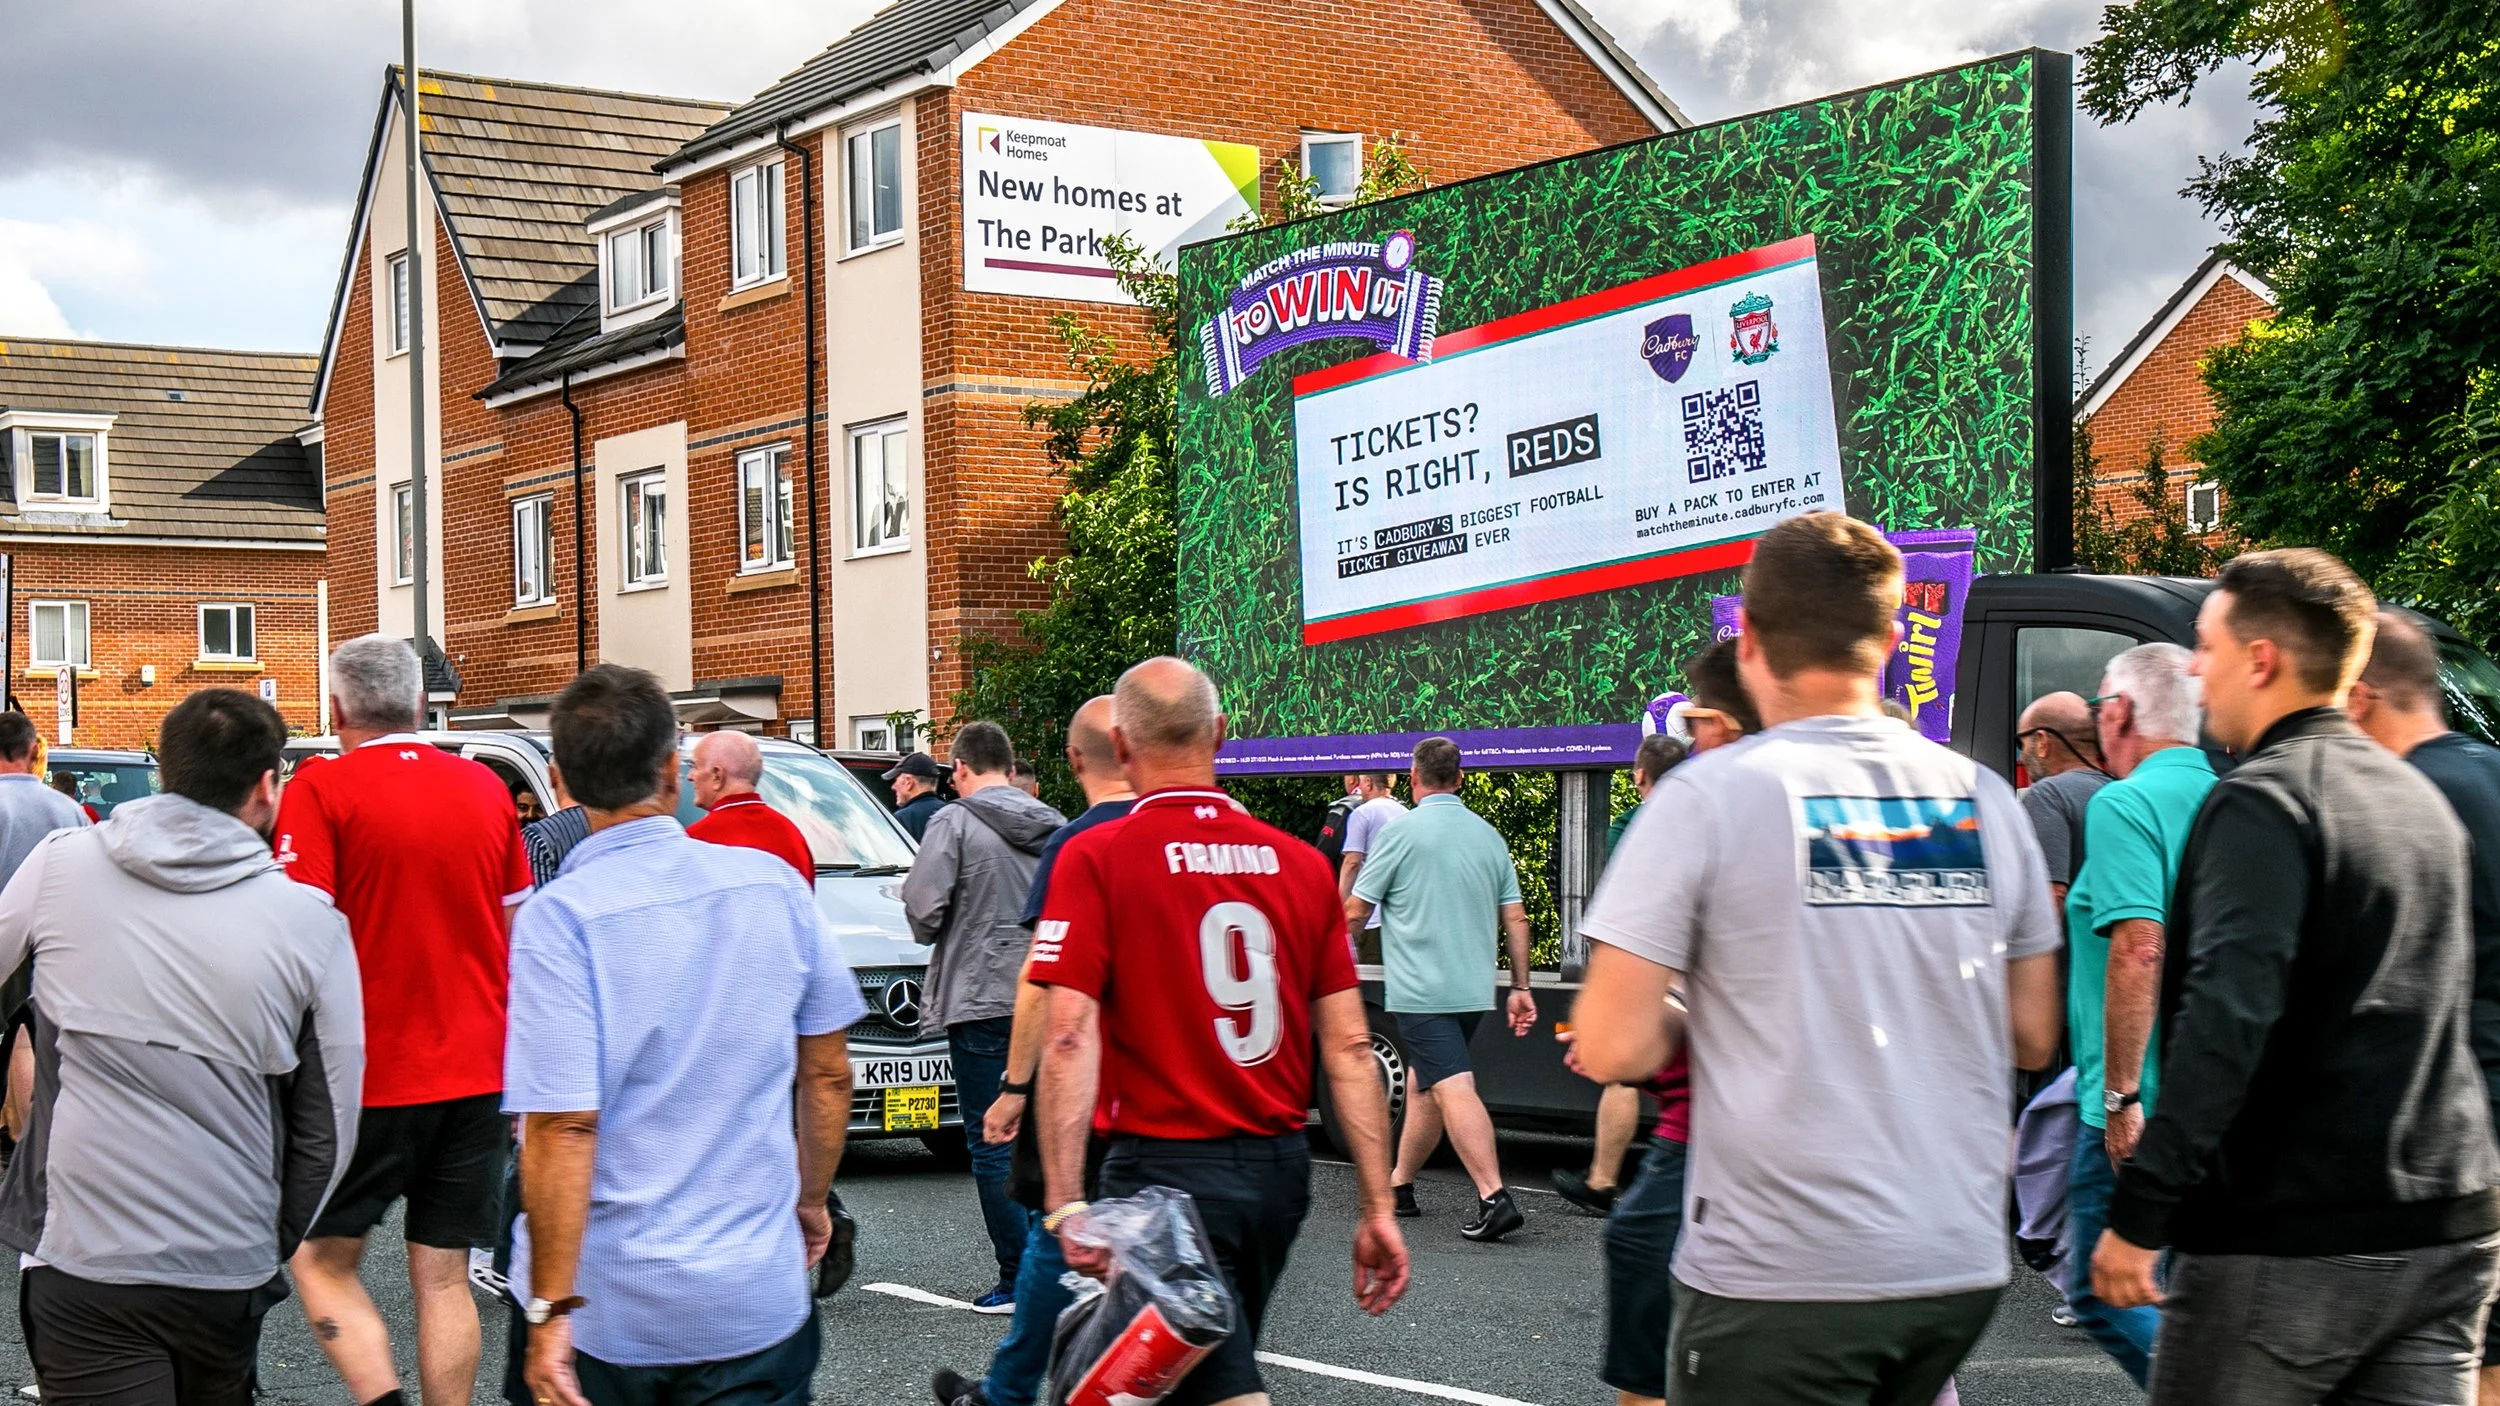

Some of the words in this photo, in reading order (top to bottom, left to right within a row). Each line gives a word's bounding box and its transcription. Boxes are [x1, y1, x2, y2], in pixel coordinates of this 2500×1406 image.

[1006, 130, 1067, 148] Keepmoat
[1007, 146, 1048, 162] Homes
[979, 170, 1044, 202] New
[1054, 176, 1147, 214] homes
[1156, 191, 1183, 217] at
[978, 219, 1031, 251] The
[1240, 256, 1291, 291] MATCH
[1291, 247, 1321, 265] THE
[1323, 242, 1381, 258] MINUTE
[1230, 301, 1272, 345] TO
[1266, 266, 1372, 333] WIN
[1370, 277, 1406, 318] IT
[1736, 314, 1768, 329] LIVERPOOL
[1641, 334, 1700, 359] Cadbury
[1674, 350, 1688, 362] FC
[1331, 403, 1479, 465] TICKETS?
[1335, 476, 1370, 511] IS
[1386, 449, 1491, 500] RIGHT,
[1511, 422, 1595, 471] REDS
[1337, 536, 1368, 555] IT'S
[1376, 518, 1451, 547] CADBURY'S
[1460, 502, 1521, 528] BIGGEST
[1530, 485, 1604, 513] FOOTBALL
[1635, 505, 1660, 522] BUY
[1668, 503, 1677, 515] A
[1684, 493, 1719, 512] PACK
[1726, 488, 1743, 503] TO
[1752, 477, 1796, 499] ENTER
[1804, 472, 1822, 488] AT
[1636, 493, 1825, 539] matchtheminute.cadburyfc.com
[1340, 553, 1390, 575] TICKET
[1397, 537, 1465, 563] GIVEAWAY
[1475, 528, 1511, 547] EVER
[1899, 611, 1942, 721] Twirl
[1164, 842, 1280, 876] FIRMINO
[1200, 901, 1284, 1067] 9
[866, 1061, 913, 1085] KR19
[908, 1097, 936, 1111] P2730
